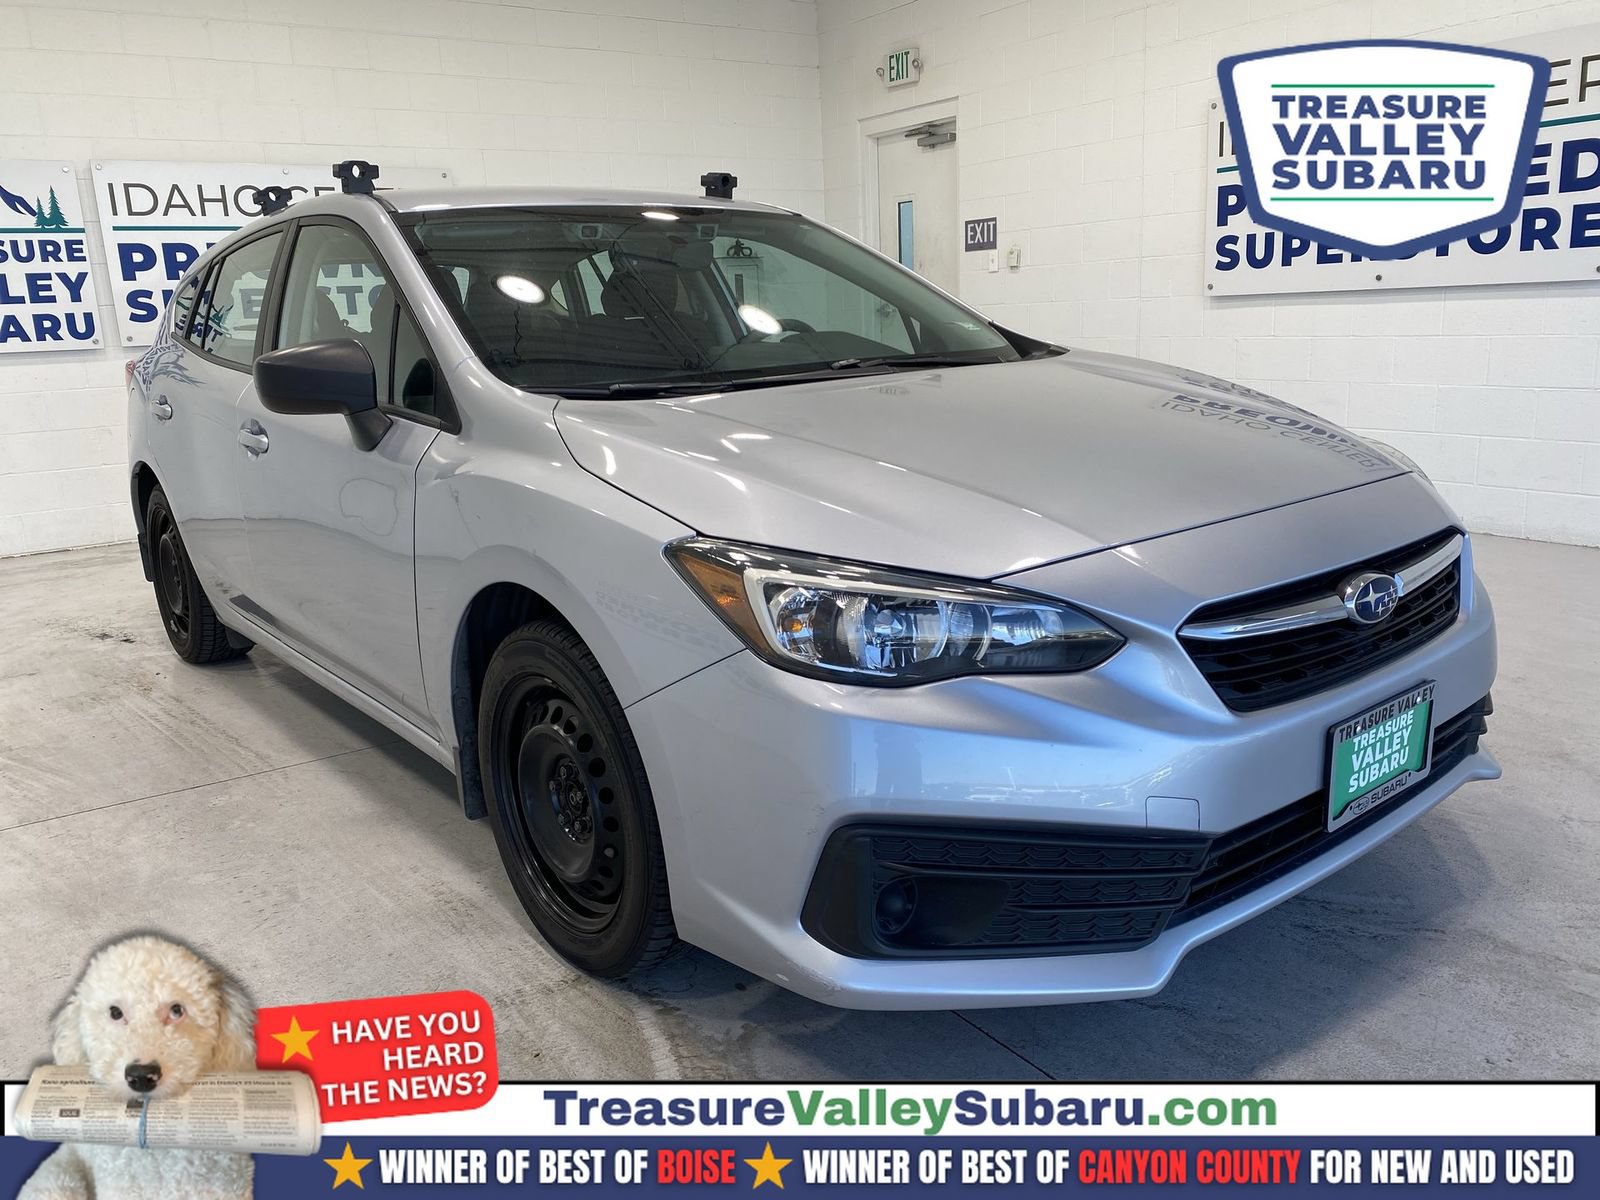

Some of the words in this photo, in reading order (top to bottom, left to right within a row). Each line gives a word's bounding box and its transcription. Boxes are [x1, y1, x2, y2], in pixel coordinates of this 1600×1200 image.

[888, 50, 911, 83] EXIT
[967, 220, 996, 244] EXIT
[1339, 704, 1395, 743] TREASURE
[1397, 684, 1436, 715] VALLEY
[1352, 709, 1415, 752] TREASURE
[1348, 746, 1410, 794] SUBARU
[1351, 726, 1412, 773] VALLEY
[1371, 775, 1408, 804] SUBARU
